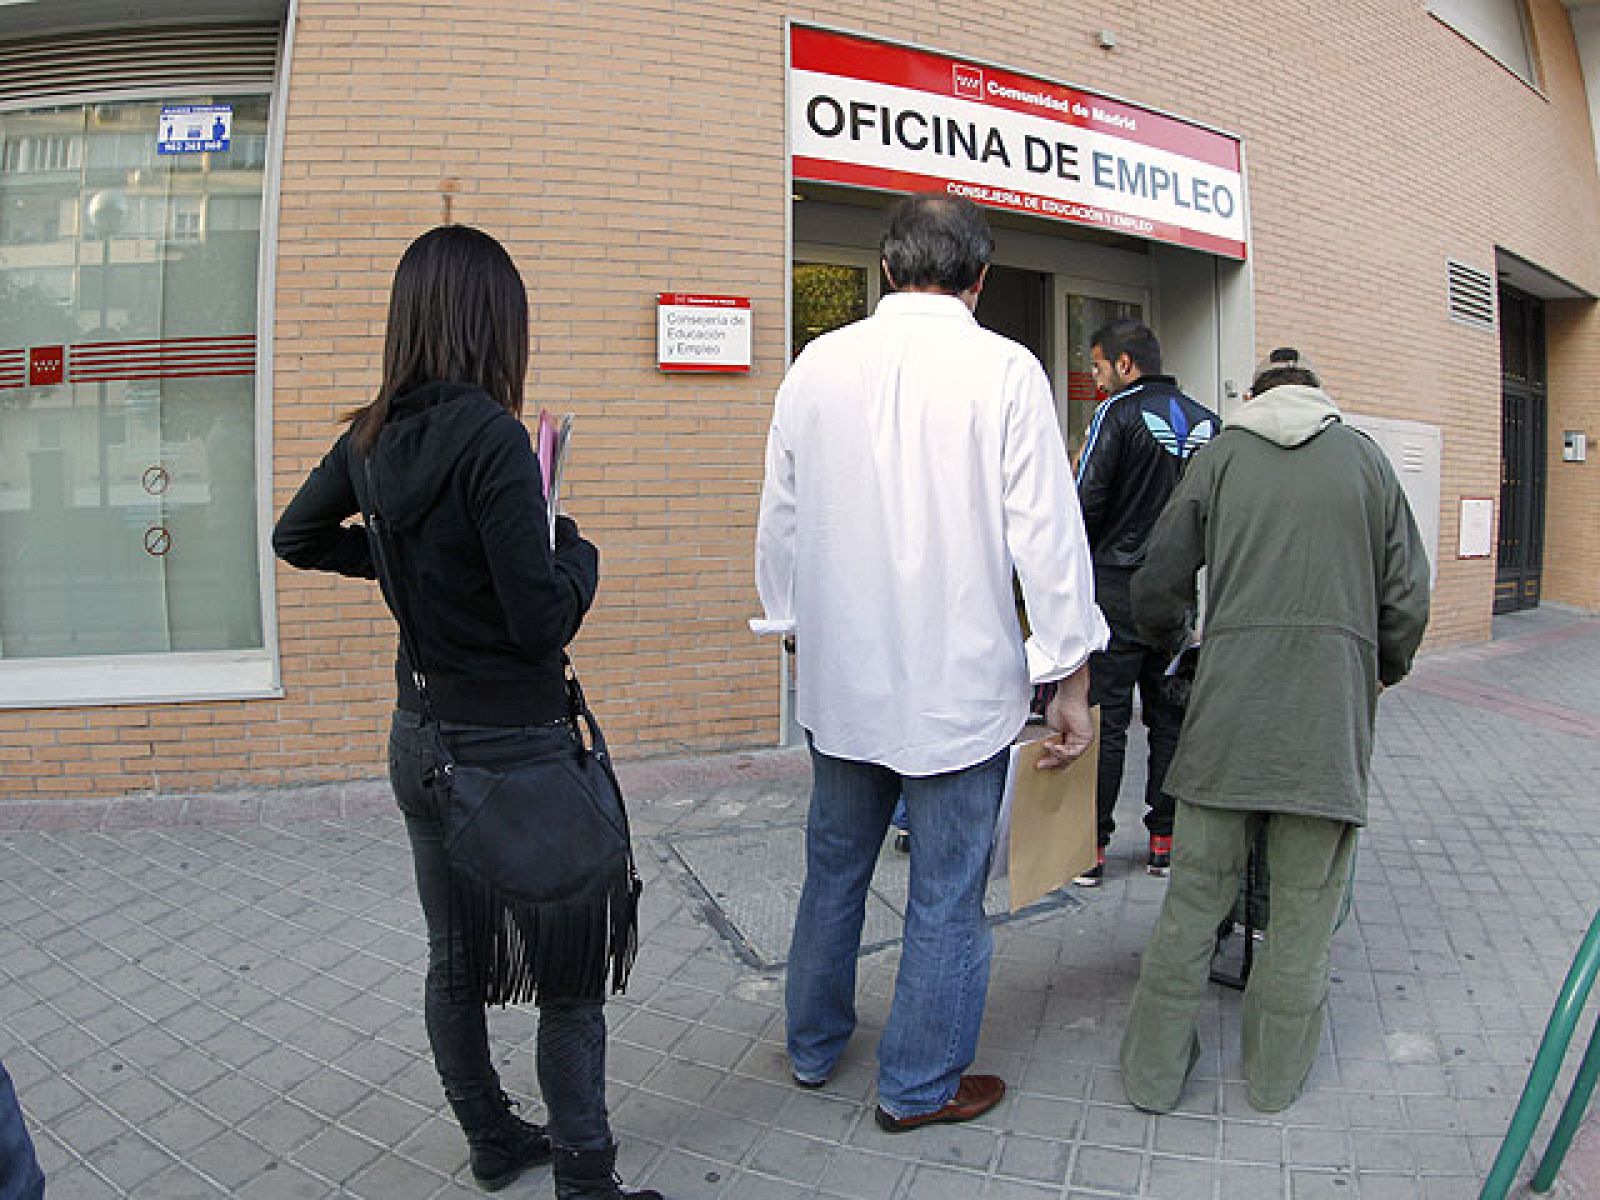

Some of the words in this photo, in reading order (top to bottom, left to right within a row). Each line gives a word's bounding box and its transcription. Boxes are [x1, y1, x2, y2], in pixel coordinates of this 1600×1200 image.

[807, 95, 1011, 168] OFICINA
[1025, 135, 1080, 182] DE
[1092, 150, 1234, 218] EMPLEO
[677, 341, 721, 356] Empleo
